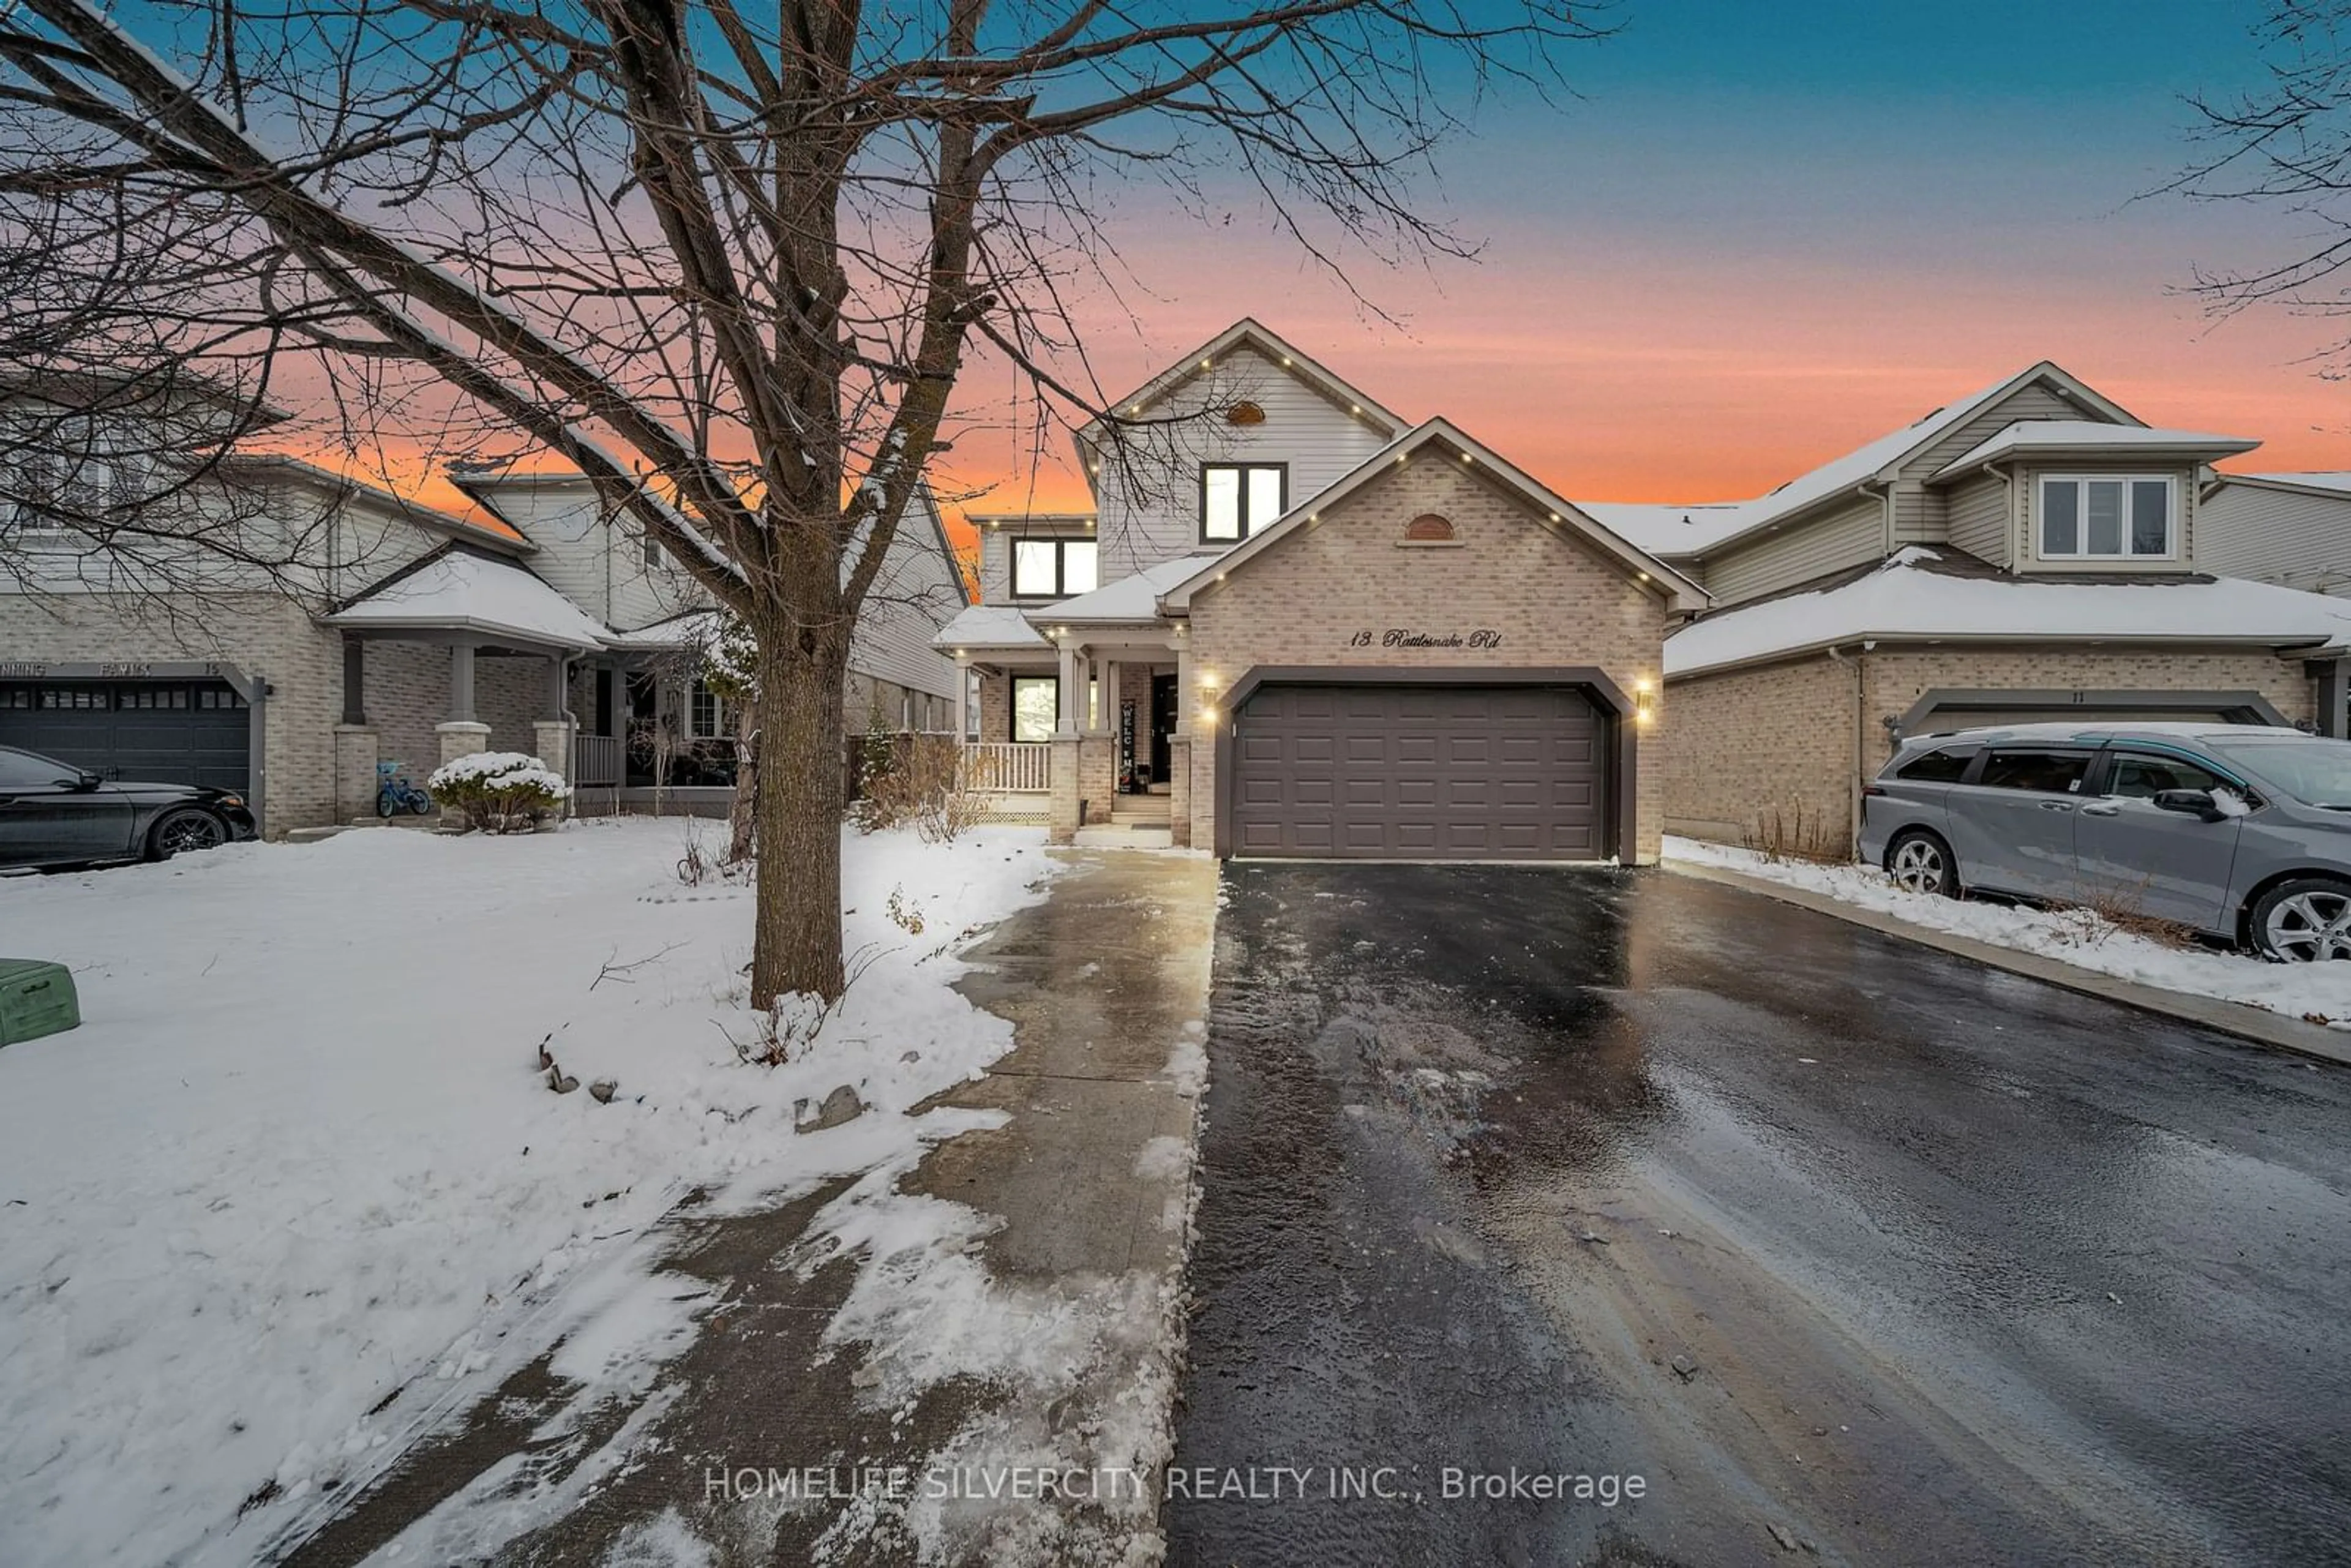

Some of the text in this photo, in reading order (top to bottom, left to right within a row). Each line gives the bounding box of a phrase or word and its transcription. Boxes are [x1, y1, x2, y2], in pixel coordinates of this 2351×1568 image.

[1351, 629, 1502, 649] 13 Rattlesnake Rd
[2073, 691, 2084, 703] 11
